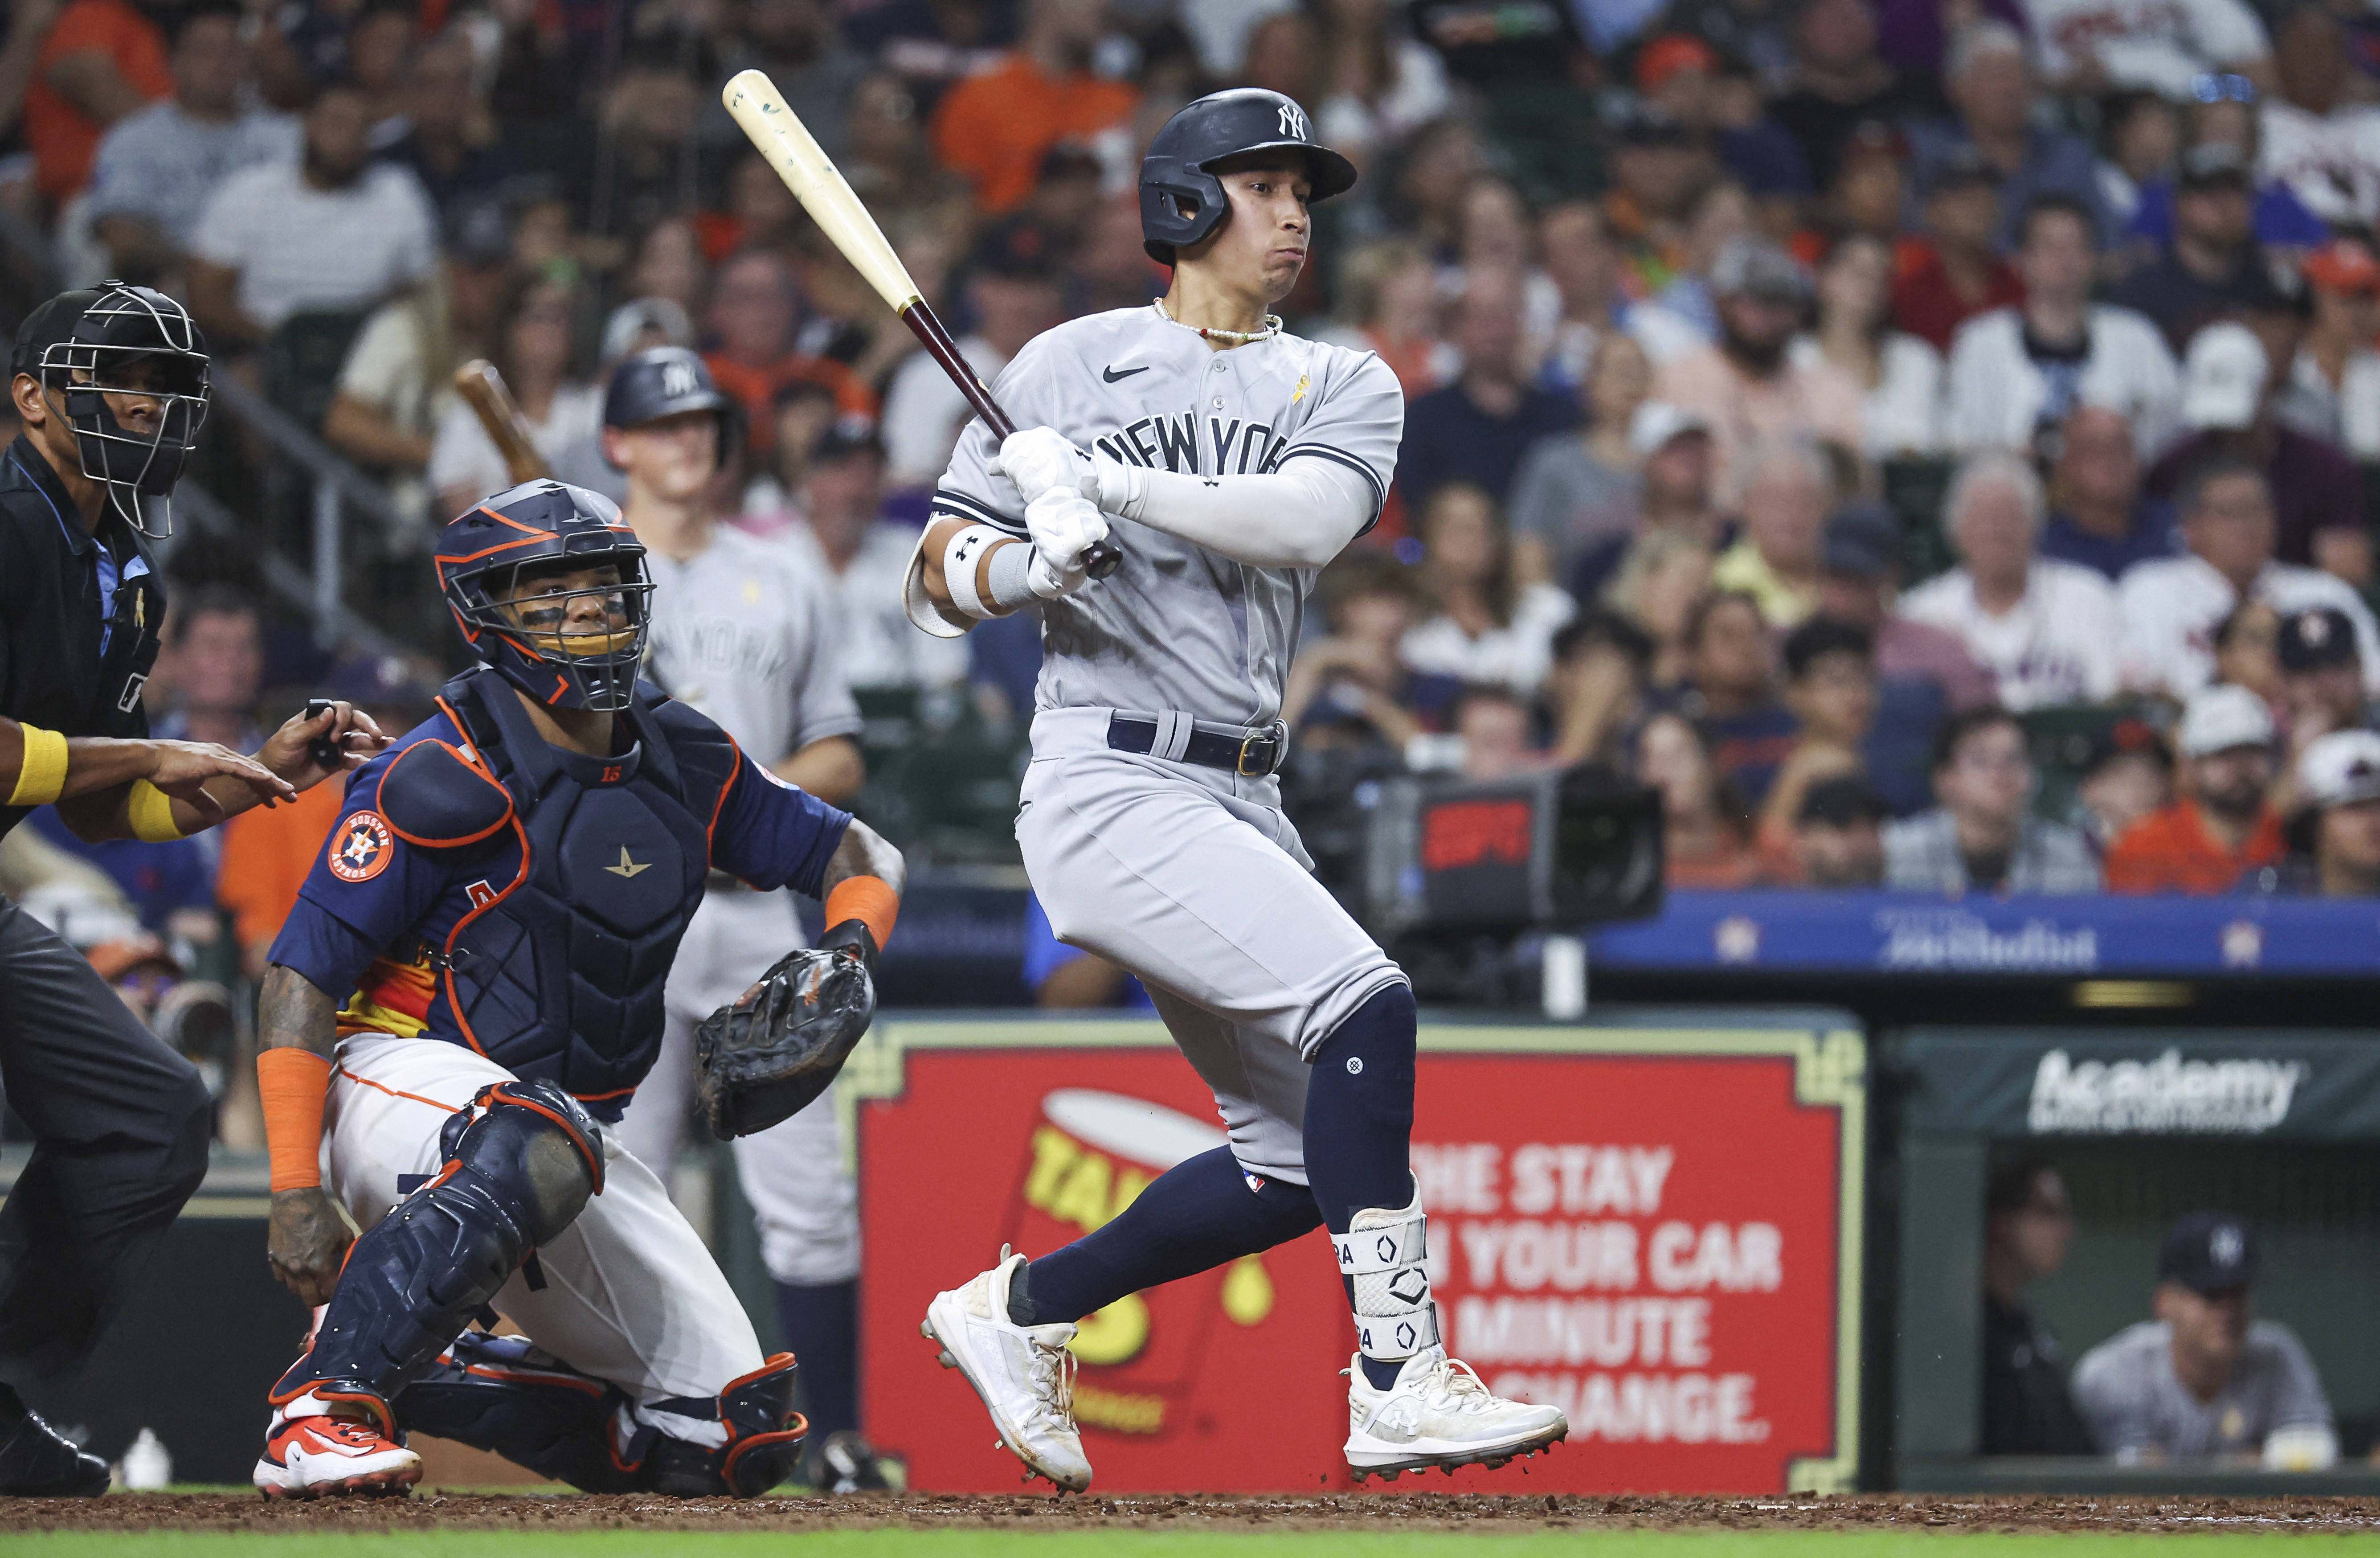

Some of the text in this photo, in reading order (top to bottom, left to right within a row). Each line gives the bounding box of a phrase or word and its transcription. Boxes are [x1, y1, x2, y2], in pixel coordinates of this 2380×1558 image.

[1277, 103, 1307, 142] NY
[601, 766, 622, 782] 15
[349, 815, 390, 846] HOUSTON
[331, 853, 367, 878] ASTROS
[2027, 1047, 2302, 1135] Academy
[1510, 1142, 1674, 1216] STAY
[1459, 1219, 1640, 1292] YOUR
[1648, 1220, 1781, 1292] CAR
[1455, 1295, 1712, 1367] MINUTE
